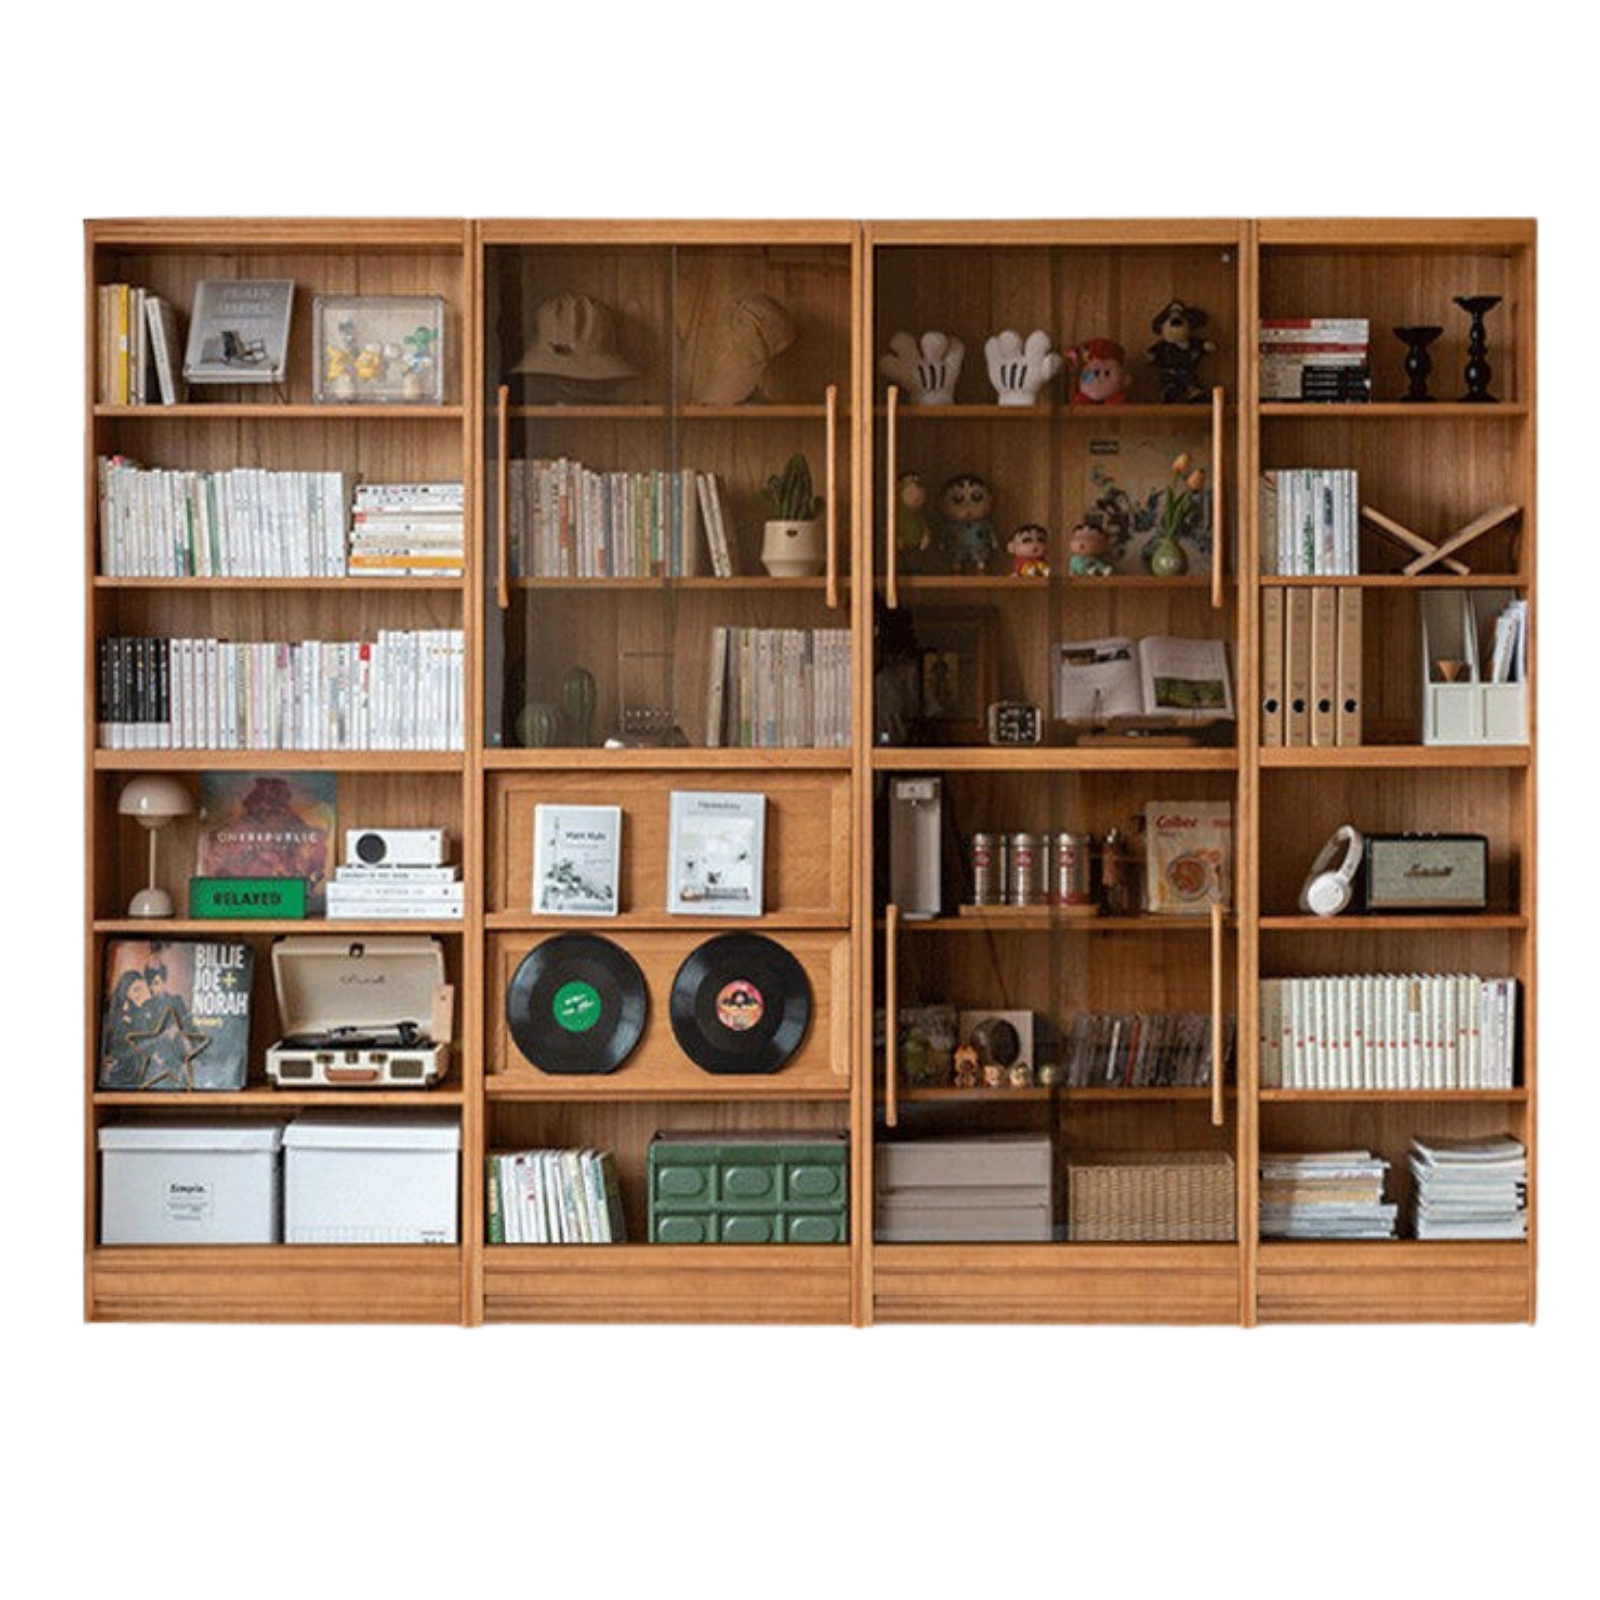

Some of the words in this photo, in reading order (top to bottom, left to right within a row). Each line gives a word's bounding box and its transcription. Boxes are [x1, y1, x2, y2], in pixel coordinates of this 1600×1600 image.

[213, 892, 282, 906] RELAXED
[195, 944, 245, 969] BILLIE
[191, 991, 248, 1016] NORAH
